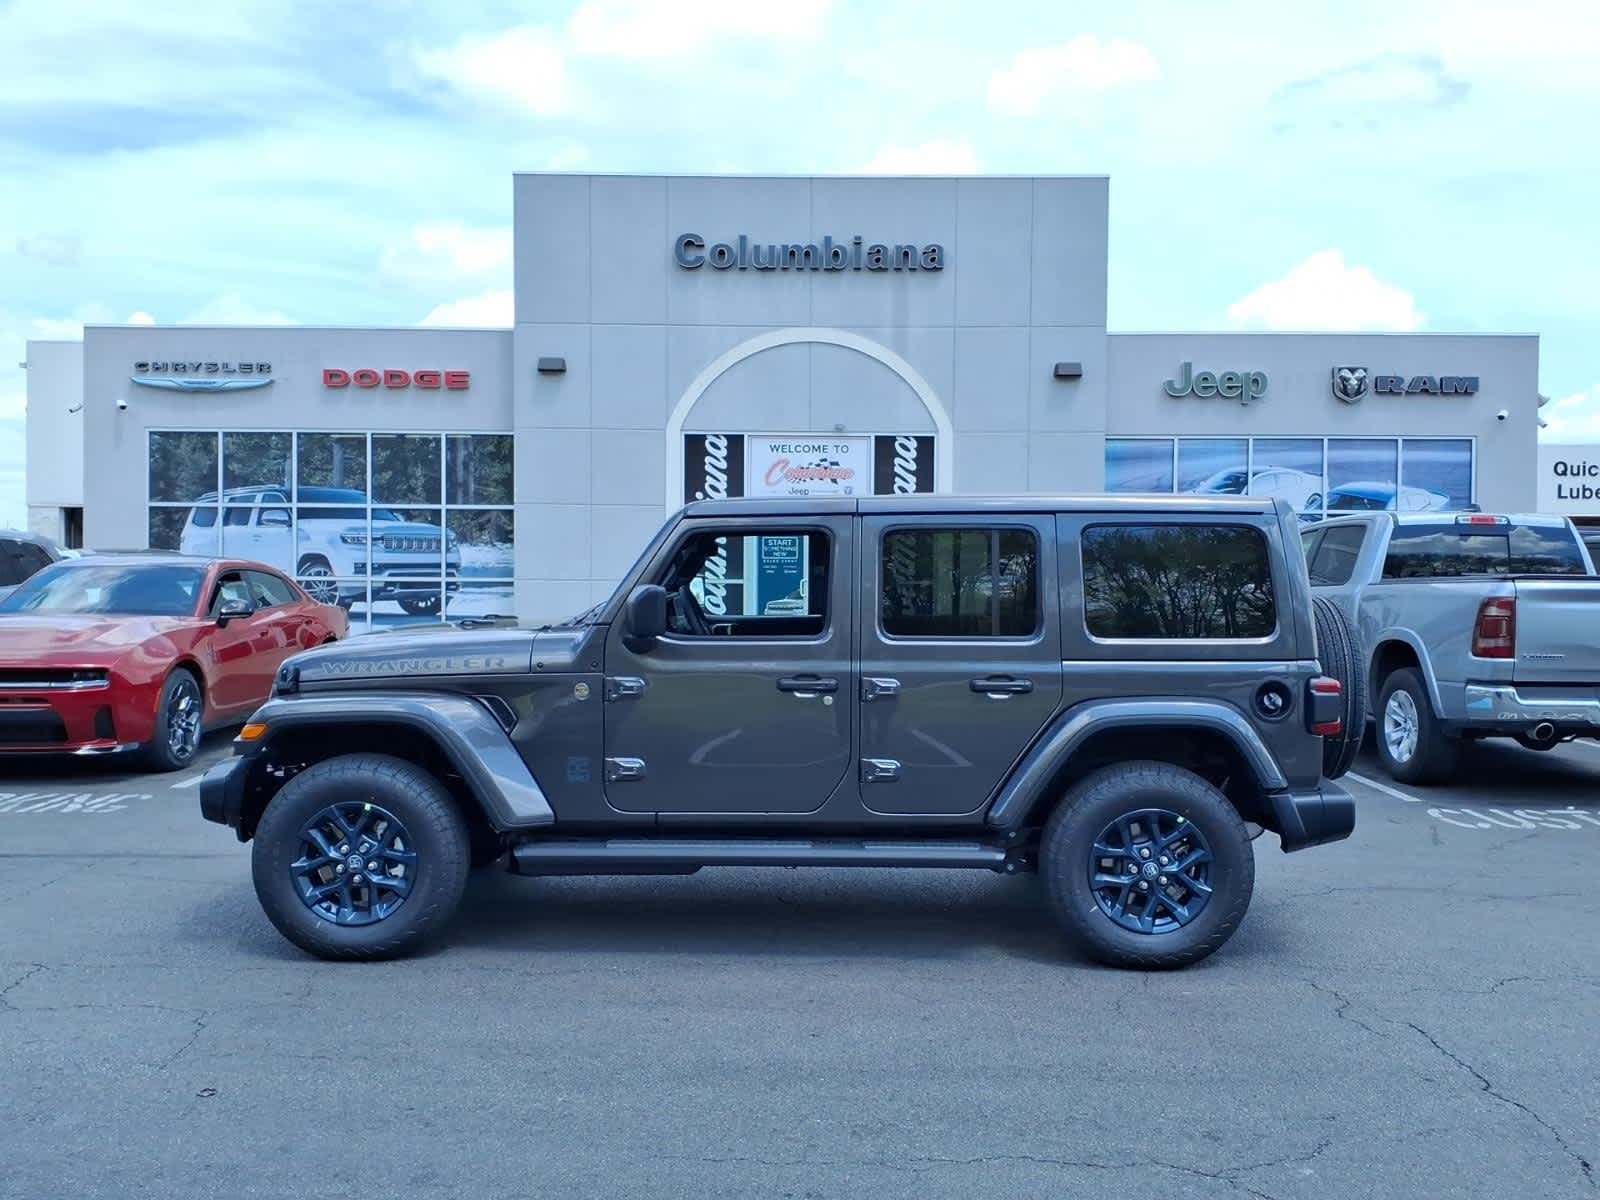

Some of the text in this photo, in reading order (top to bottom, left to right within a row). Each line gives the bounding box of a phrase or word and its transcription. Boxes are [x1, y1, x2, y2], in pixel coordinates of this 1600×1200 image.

[674, 233, 945, 271] Columbiana
[135, 361, 272, 373] CHRYSLER
[322, 369, 470, 390] DODGE
[1163, 361, 1268, 406] Jeep
[1375, 375, 1479, 396] RAM
[769, 444, 849, 454] WELCOME TO
[1553, 461, 1600, 477] Quic
[1557, 484, 1600, 499] Lube
[322, 657, 506, 675] WRANGLER
[1427, 807, 1600, 829] CUST
